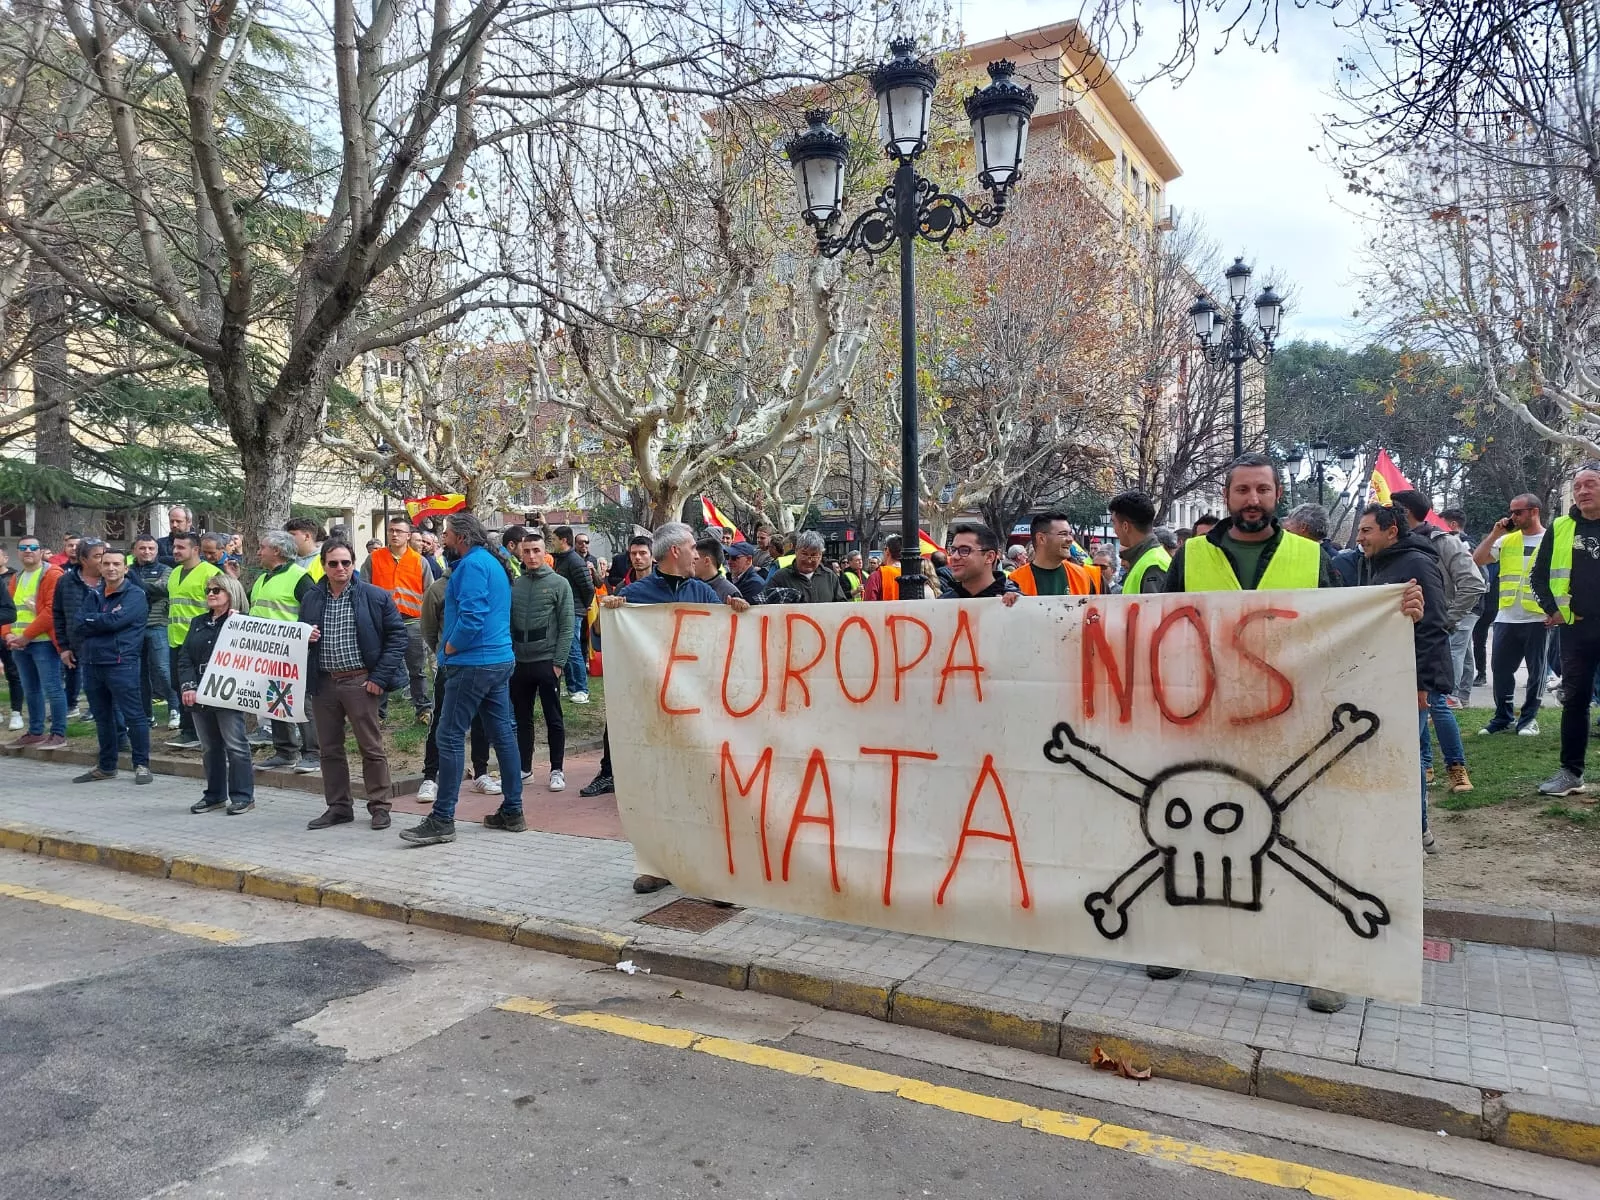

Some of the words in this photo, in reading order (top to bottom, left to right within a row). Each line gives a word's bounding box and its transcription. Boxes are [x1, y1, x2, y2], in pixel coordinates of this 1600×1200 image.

[228, 621, 240, 630] SIN
[240, 620, 302, 640] AGRICULTURA
[230, 638, 239, 648] NI
[240, 637, 290, 657] GANADERÍA
[214, 651, 231, 667] NO
[232, 654, 253, 671] HAY
[254, 657, 299, 680] COMIDA
[660, 609, 985, 717] EUROPA
[1082, 602, 1298, 726] NOS
[203, 673, 237, 700] NO
[236, 688, 261, 699] AGENDA
[237, 697, 260, 709] 2030
[720, 741, 1031, 909] MATA
